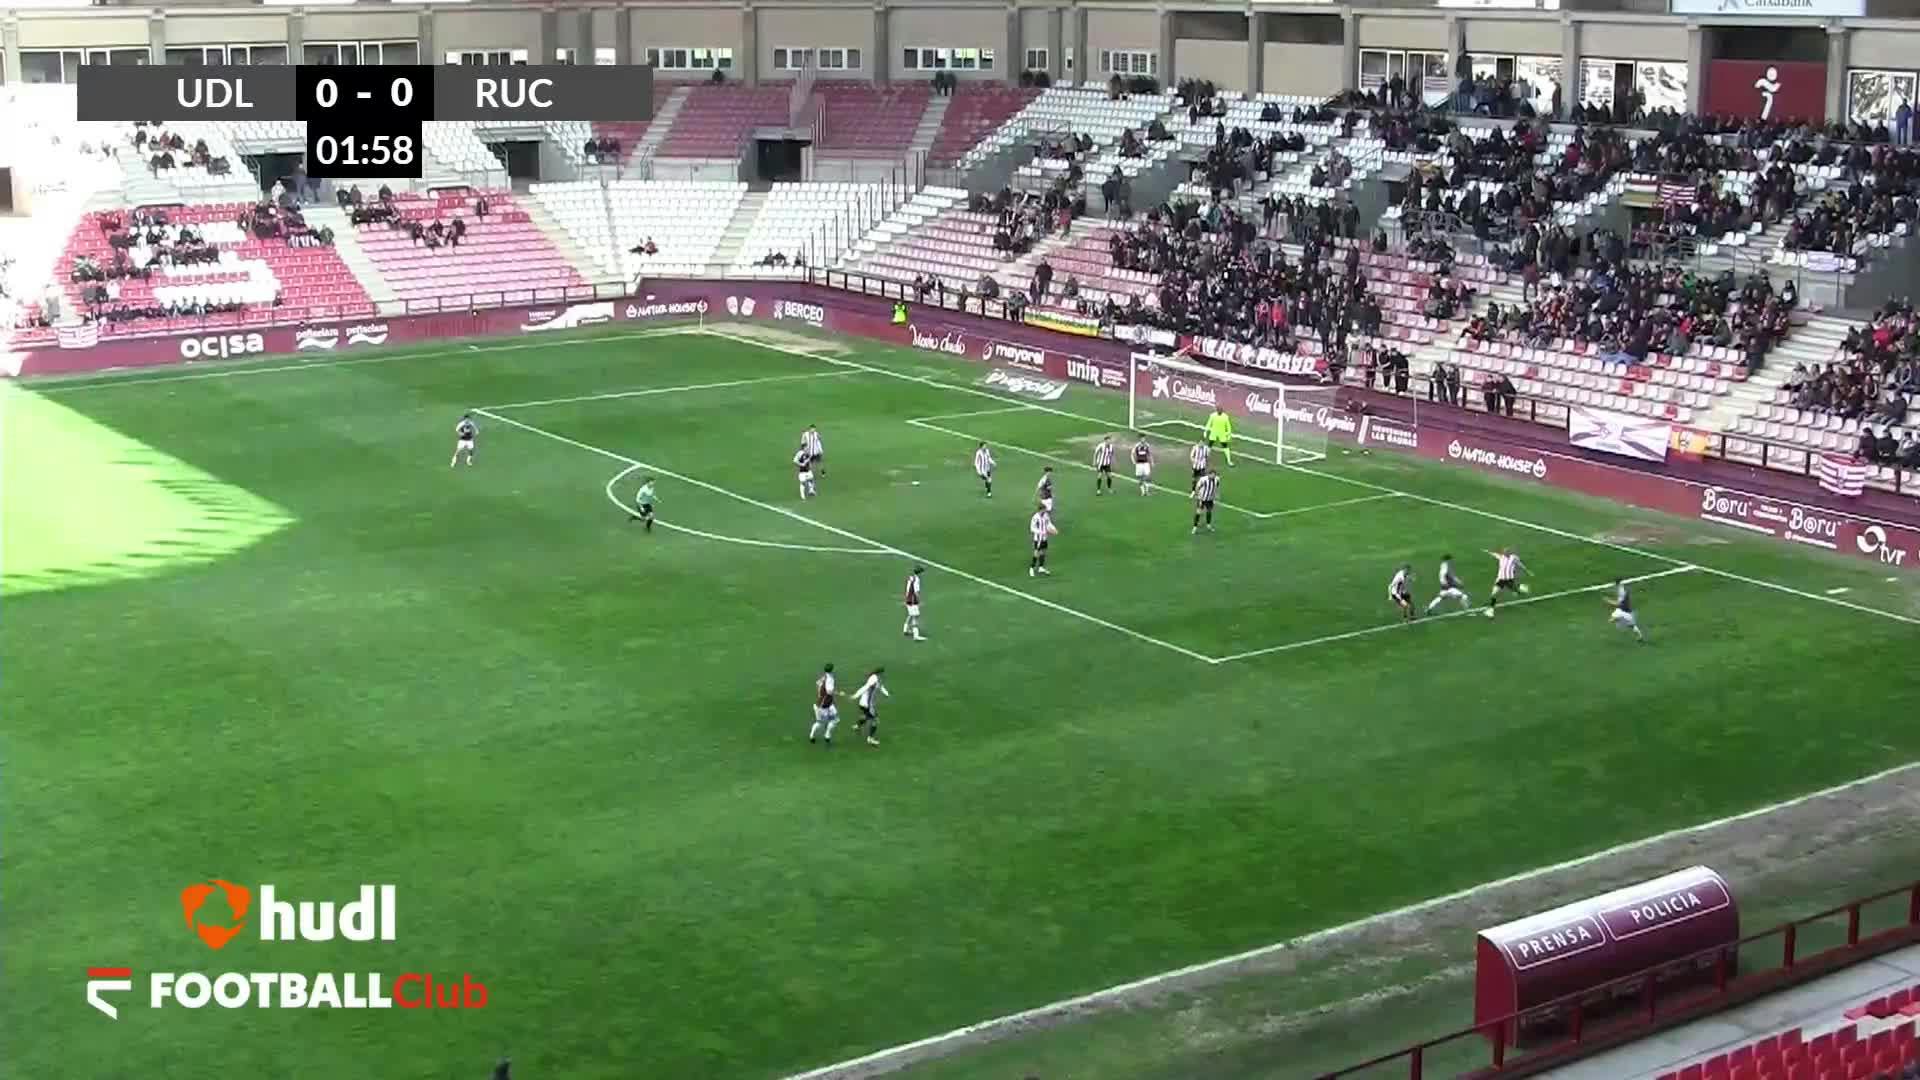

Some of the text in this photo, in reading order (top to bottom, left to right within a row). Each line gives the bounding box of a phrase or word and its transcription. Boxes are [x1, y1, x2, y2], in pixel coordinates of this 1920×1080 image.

[785, 301, 824, 321] BERCEO
[1172, 380, 1216, 401] CaixaBank
[1518, 925, 1591, 958] PRENSA
